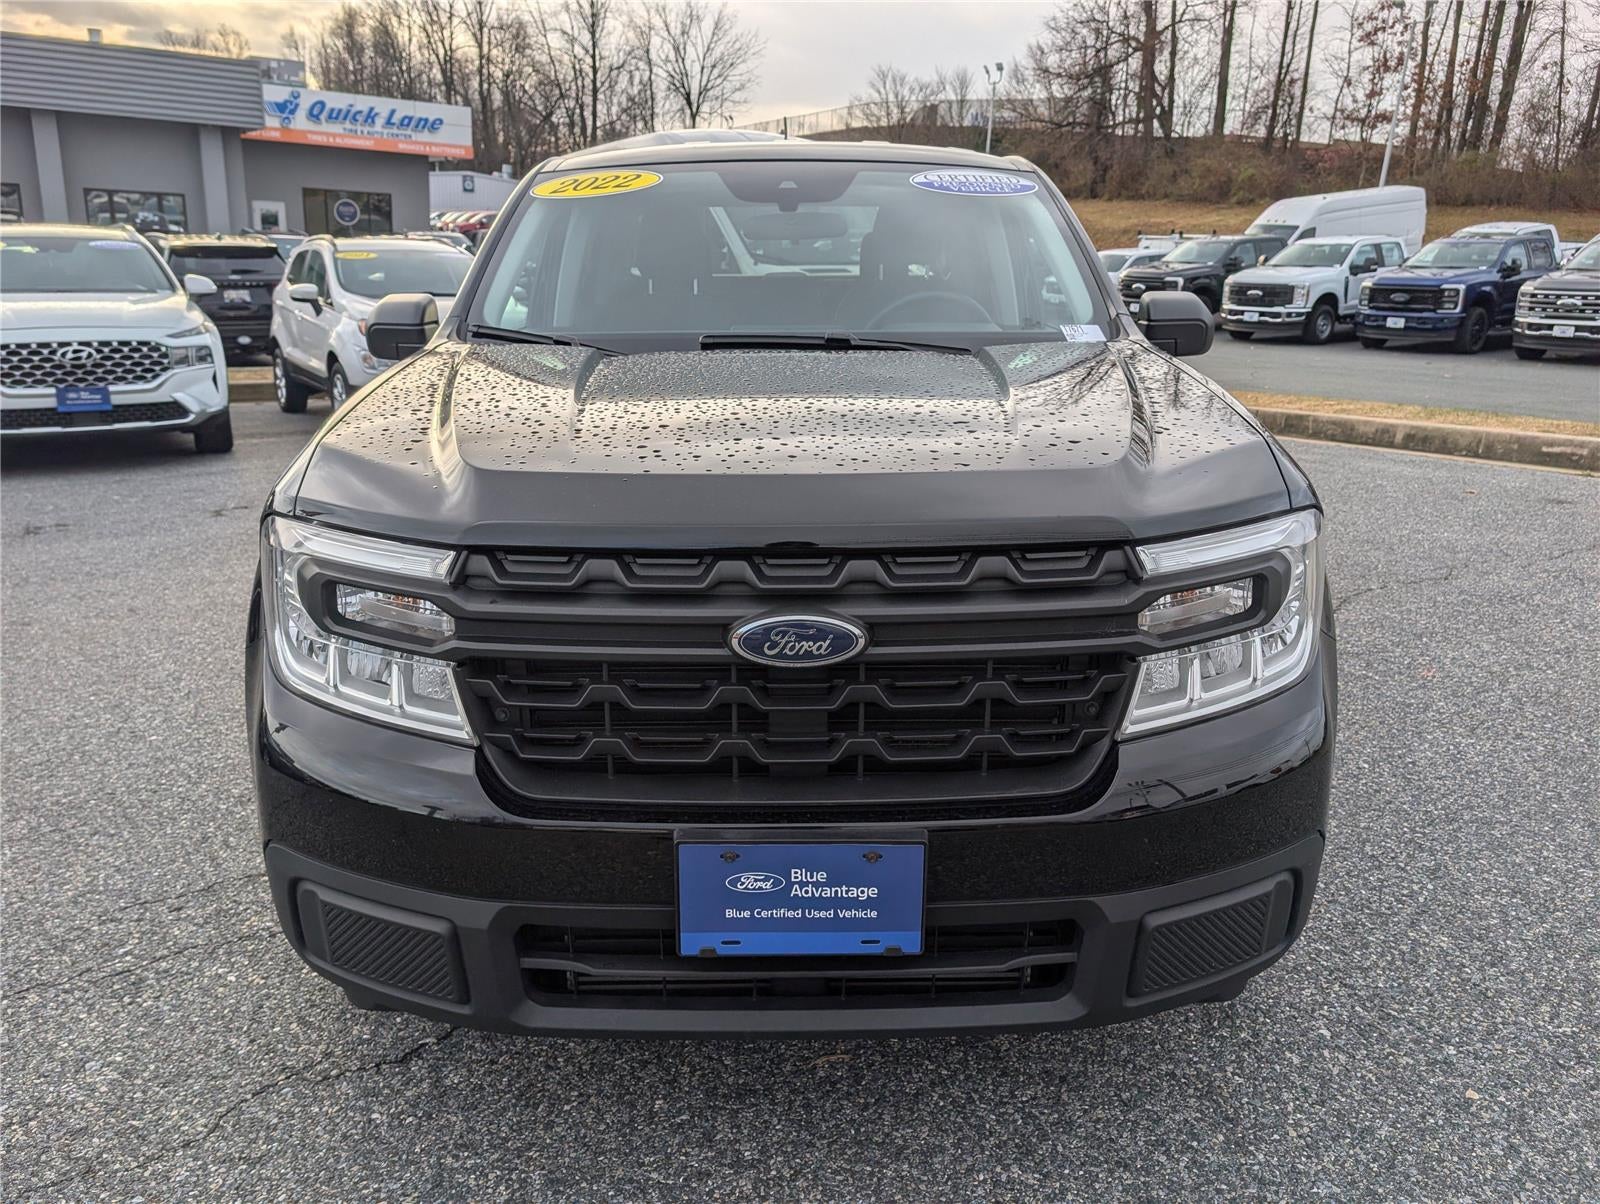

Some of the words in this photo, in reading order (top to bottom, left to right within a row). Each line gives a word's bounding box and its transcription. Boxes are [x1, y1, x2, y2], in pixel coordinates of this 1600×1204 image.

[307, 99, 380, 125] Quick
[384, 108, 445, 131] Lane
[386, 131, 412, 139] CENTER
[549, 173, 642, 195] 2022
[923, 173, 1021, 184] CERTIFIED
[763, 627, 834, 656] Ford
[737, 875, 774, 890] Ford
[790, 868, 827, 882] Blue
[790, 884, 878, 900] Advantage
[725, 908, 750, 918] Blue
[754, 908, 802, 918] Certified
[805, 908, 834, 918] Used
[837, 908, 878, 918] Vehicle
